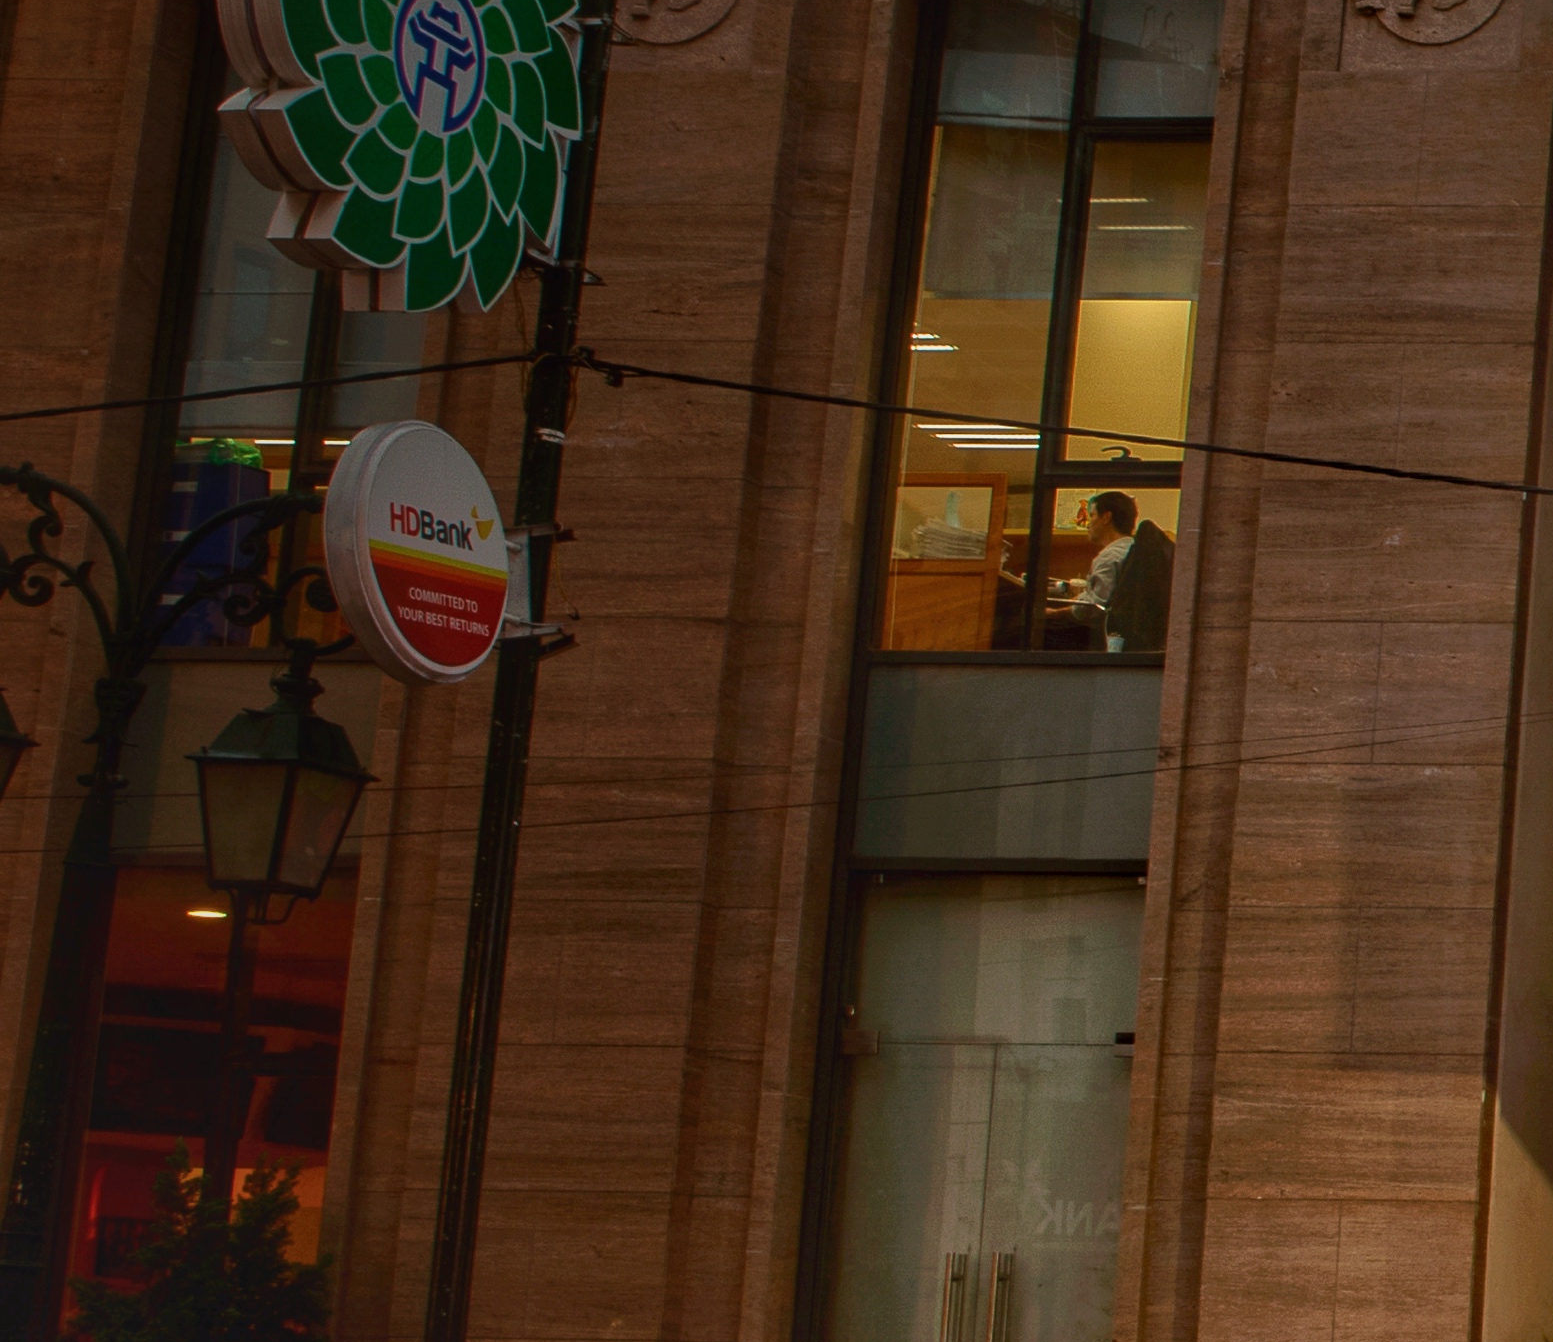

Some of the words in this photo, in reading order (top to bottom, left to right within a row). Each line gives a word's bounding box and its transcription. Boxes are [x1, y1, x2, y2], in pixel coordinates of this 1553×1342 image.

[389, 502, 474, 551] HDBank
[409, 587, 465, 610] COMMITTED
[465, 599, 478, 613] TO
[398, 605, 425, 623] YOUR
[425, 612, 448, 627] BEST
[449, 617, 490, 636] RETURNS
